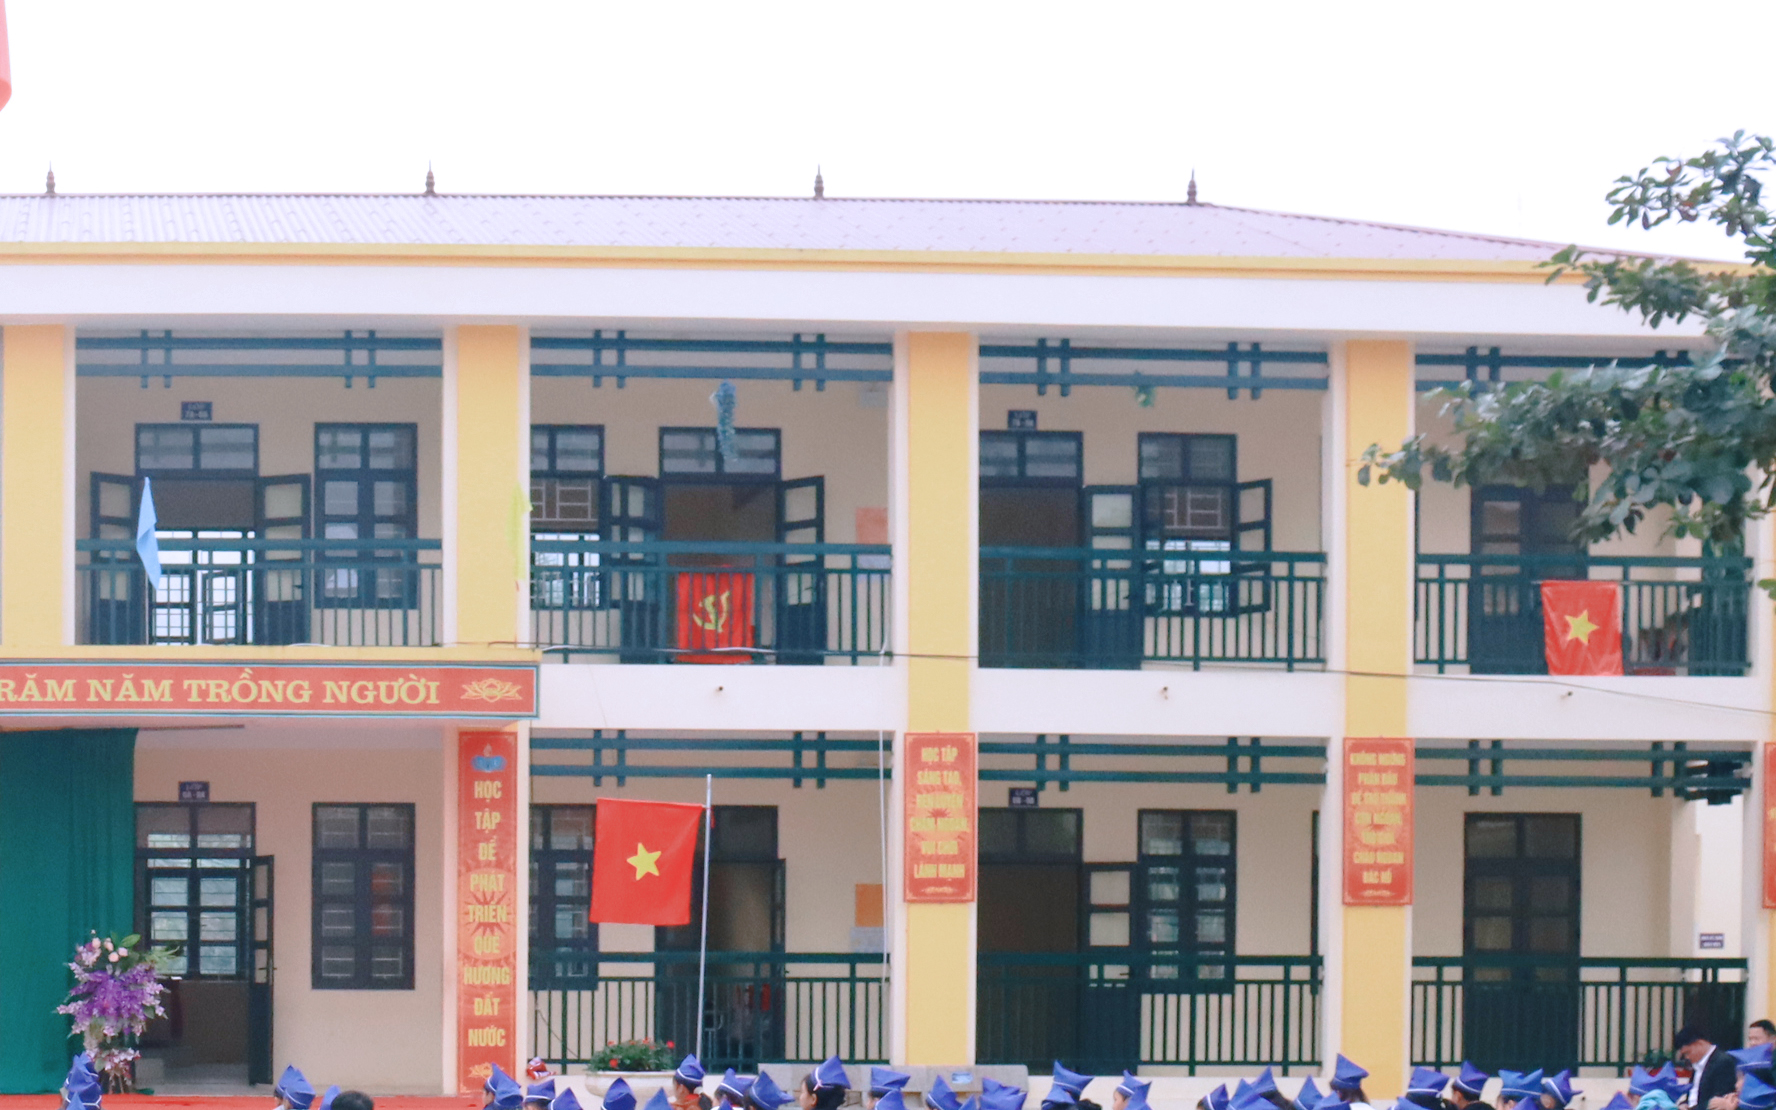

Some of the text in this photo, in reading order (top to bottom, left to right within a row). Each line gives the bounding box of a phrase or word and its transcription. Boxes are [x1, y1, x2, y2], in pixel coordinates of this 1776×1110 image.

[87, 673, 173, 703] NĂM
[183, 667, 313, 704] TRỒNG
[322, 672, 441, 705] NGƯỜI
[474, 780, 502, 803] HỌC
[474, 807, 501, 833] TẬP
[478, 835, 498, 861] ĐỂ
[470, 869, 505, 892] PHÁT
[468, 898, 508, 923] TRIỂN
[474, 932, 500, 955] QUÊ
[464, 965, 510, 985] HƯƠNG
[474, 991, 500, 1016] ĐẤT
[468, 1022, 506, 1047] NƯỚC
